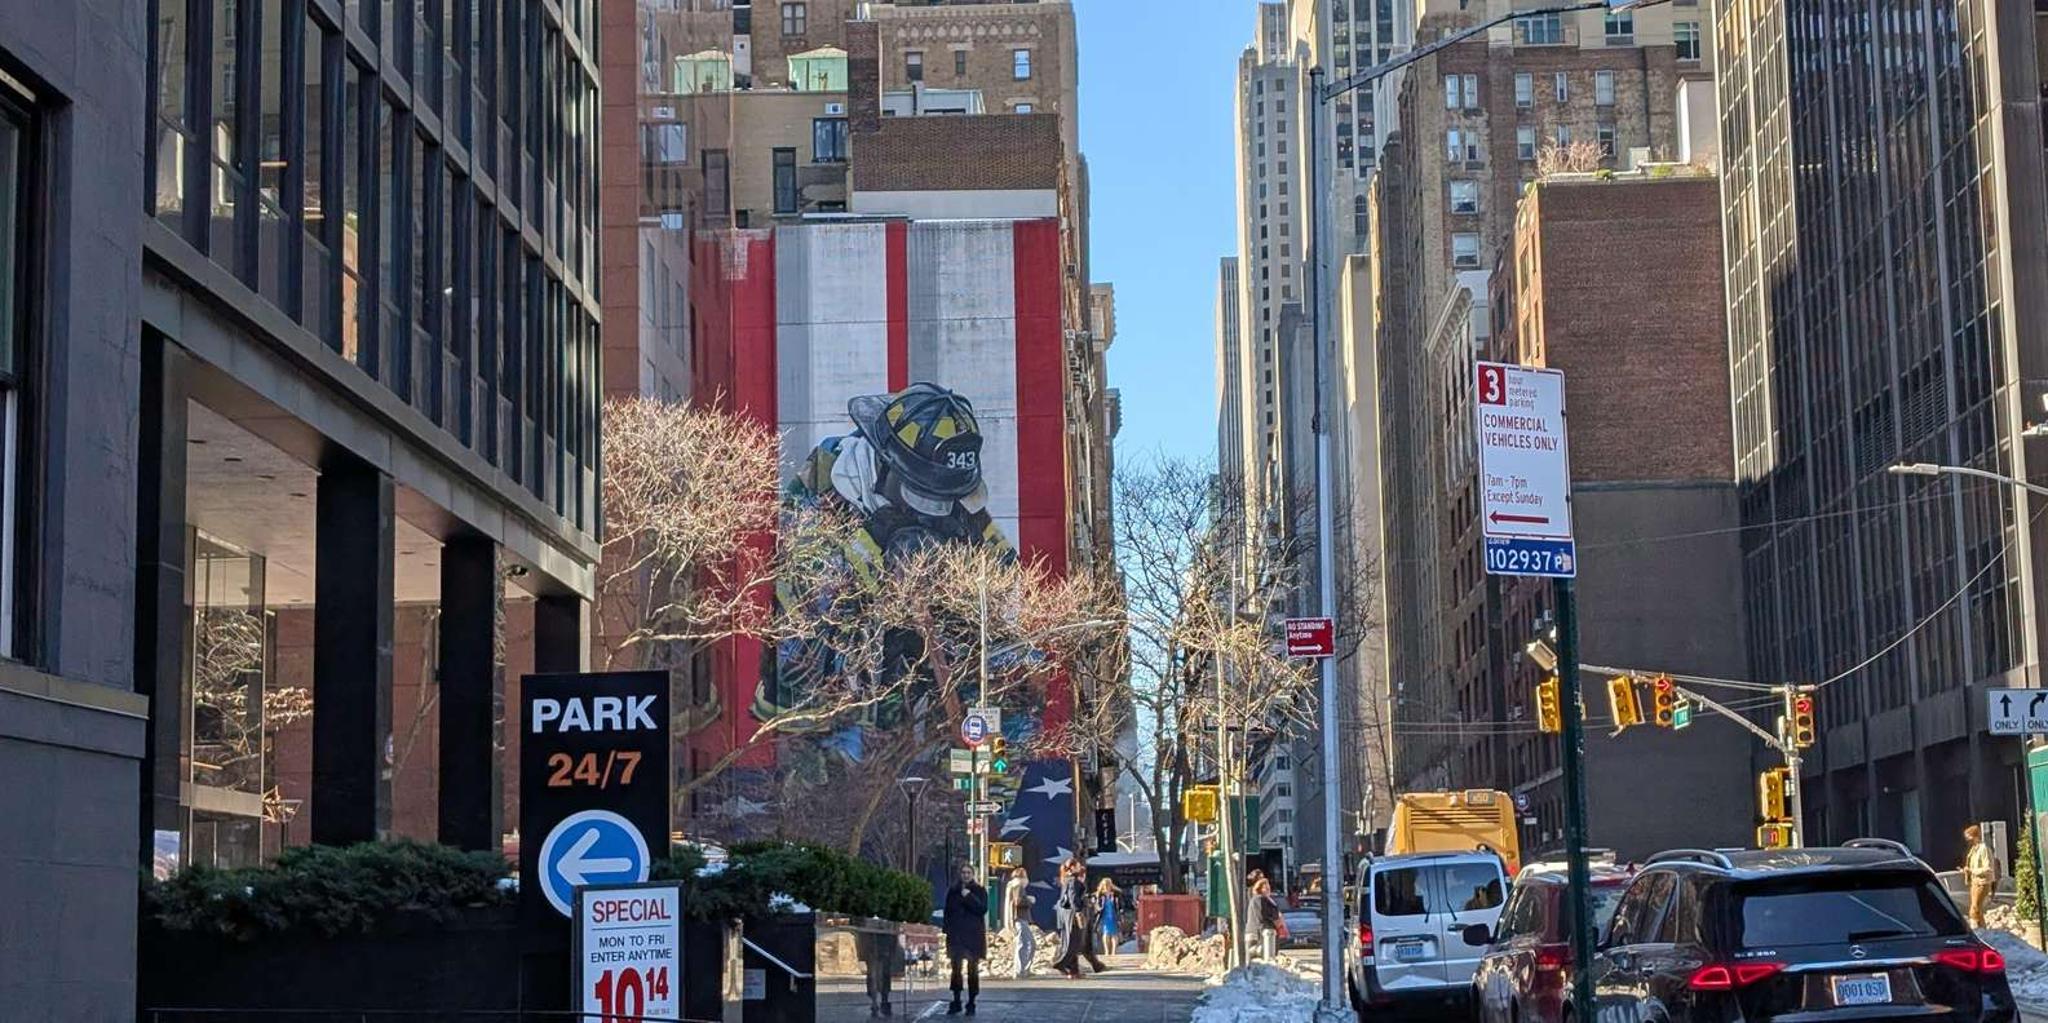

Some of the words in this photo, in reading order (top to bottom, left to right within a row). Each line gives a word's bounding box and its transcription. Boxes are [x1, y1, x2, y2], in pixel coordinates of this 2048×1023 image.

[1485, 369, 1500, 403] 3
[1509, 376, 1523, 385] hour
[1509, 387, 1537, 398] metered
[1509, 399, 1535, 411] parking
[1484, 414, 1548, 432] COMMERCIAL
[1485, 432, 1531, 449] VEHICLES
[1534, 436, 1558, 451] ONLY
[947, 451, 975, 469] 343
[1486, 473, 1503, 486] 7am
[1510, 475, 1527, 489] 7pm
[1487, 490, 1513, 505] Except
[1515, 491, 1543, 507] Sunday
[1489, 548, 1551, 571] 102937
[1288, 622, 1296, 630] NO
[1297, 621, 1325, 630] STANDING
[1289, 632, 1312, 640] Anytime
[532, 695, 658, 733] PARK
[1994, 720, 2019, 730] ONLY
[548, 749, 641, 790] 24/7
[591, 898, 672, 924] SPECIAL
[599, 936, 625, 948] MON
[630, 935, 645, 946] TO
[648, 934, 665, 945] FRI
[591, 951, 626, 963] ENTER
[628, 948, 672, 961] ANYTIME
[594, 966, 644, 1023] 10
[645, 966, 669, 1002] 14
